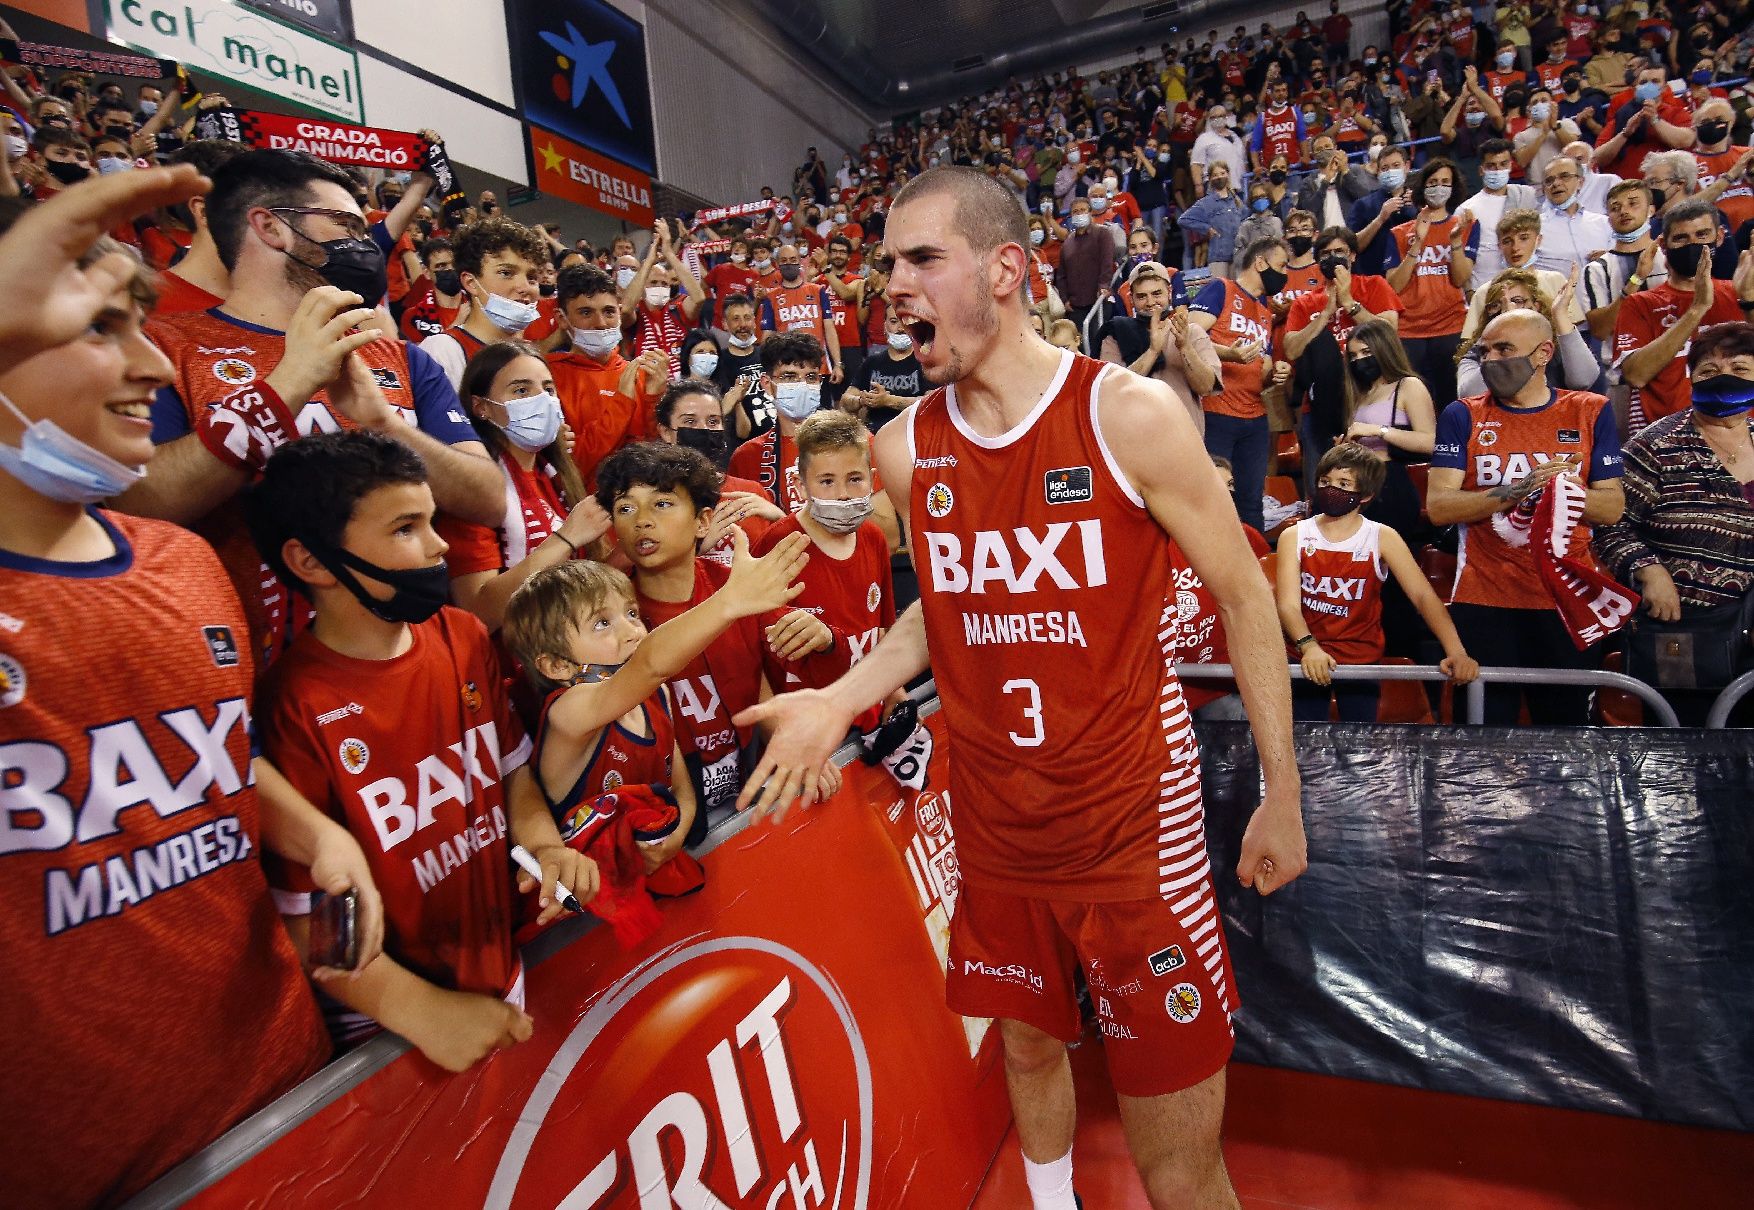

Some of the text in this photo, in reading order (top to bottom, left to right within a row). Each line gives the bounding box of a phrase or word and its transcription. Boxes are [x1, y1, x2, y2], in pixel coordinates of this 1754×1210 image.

[120, 0, 196, 46] cal
[222, 36, 353, 104] manel
[296, 122, 382, 148] GRADA
[568, 159, 652, 209] ESTRELLA
[778, 304, 819, 322] BAXI
[1049, 480, 1067, 492] liga
[1050, 488, 1089, 499] endesa
[921, 518, 1108, 594] BAXI
[1301, 571, 1367, 601] BAXI
[1302, 596, 1349, 618] MANRESA
[962, 610, 1088, 648] MANRESA
[1002, 678, 1046, 747] 3
[0, 697, 257, 856] BAX
[356, 721, 503, 853] BAXI
[918, 796, 941, 826] FRIT
[934, 851, 958, 881] TO
[963, 960, 1026, 979] Macsa
[1029, 968, 1044, 990] id
[1155, 956, 1178, 973] acb
